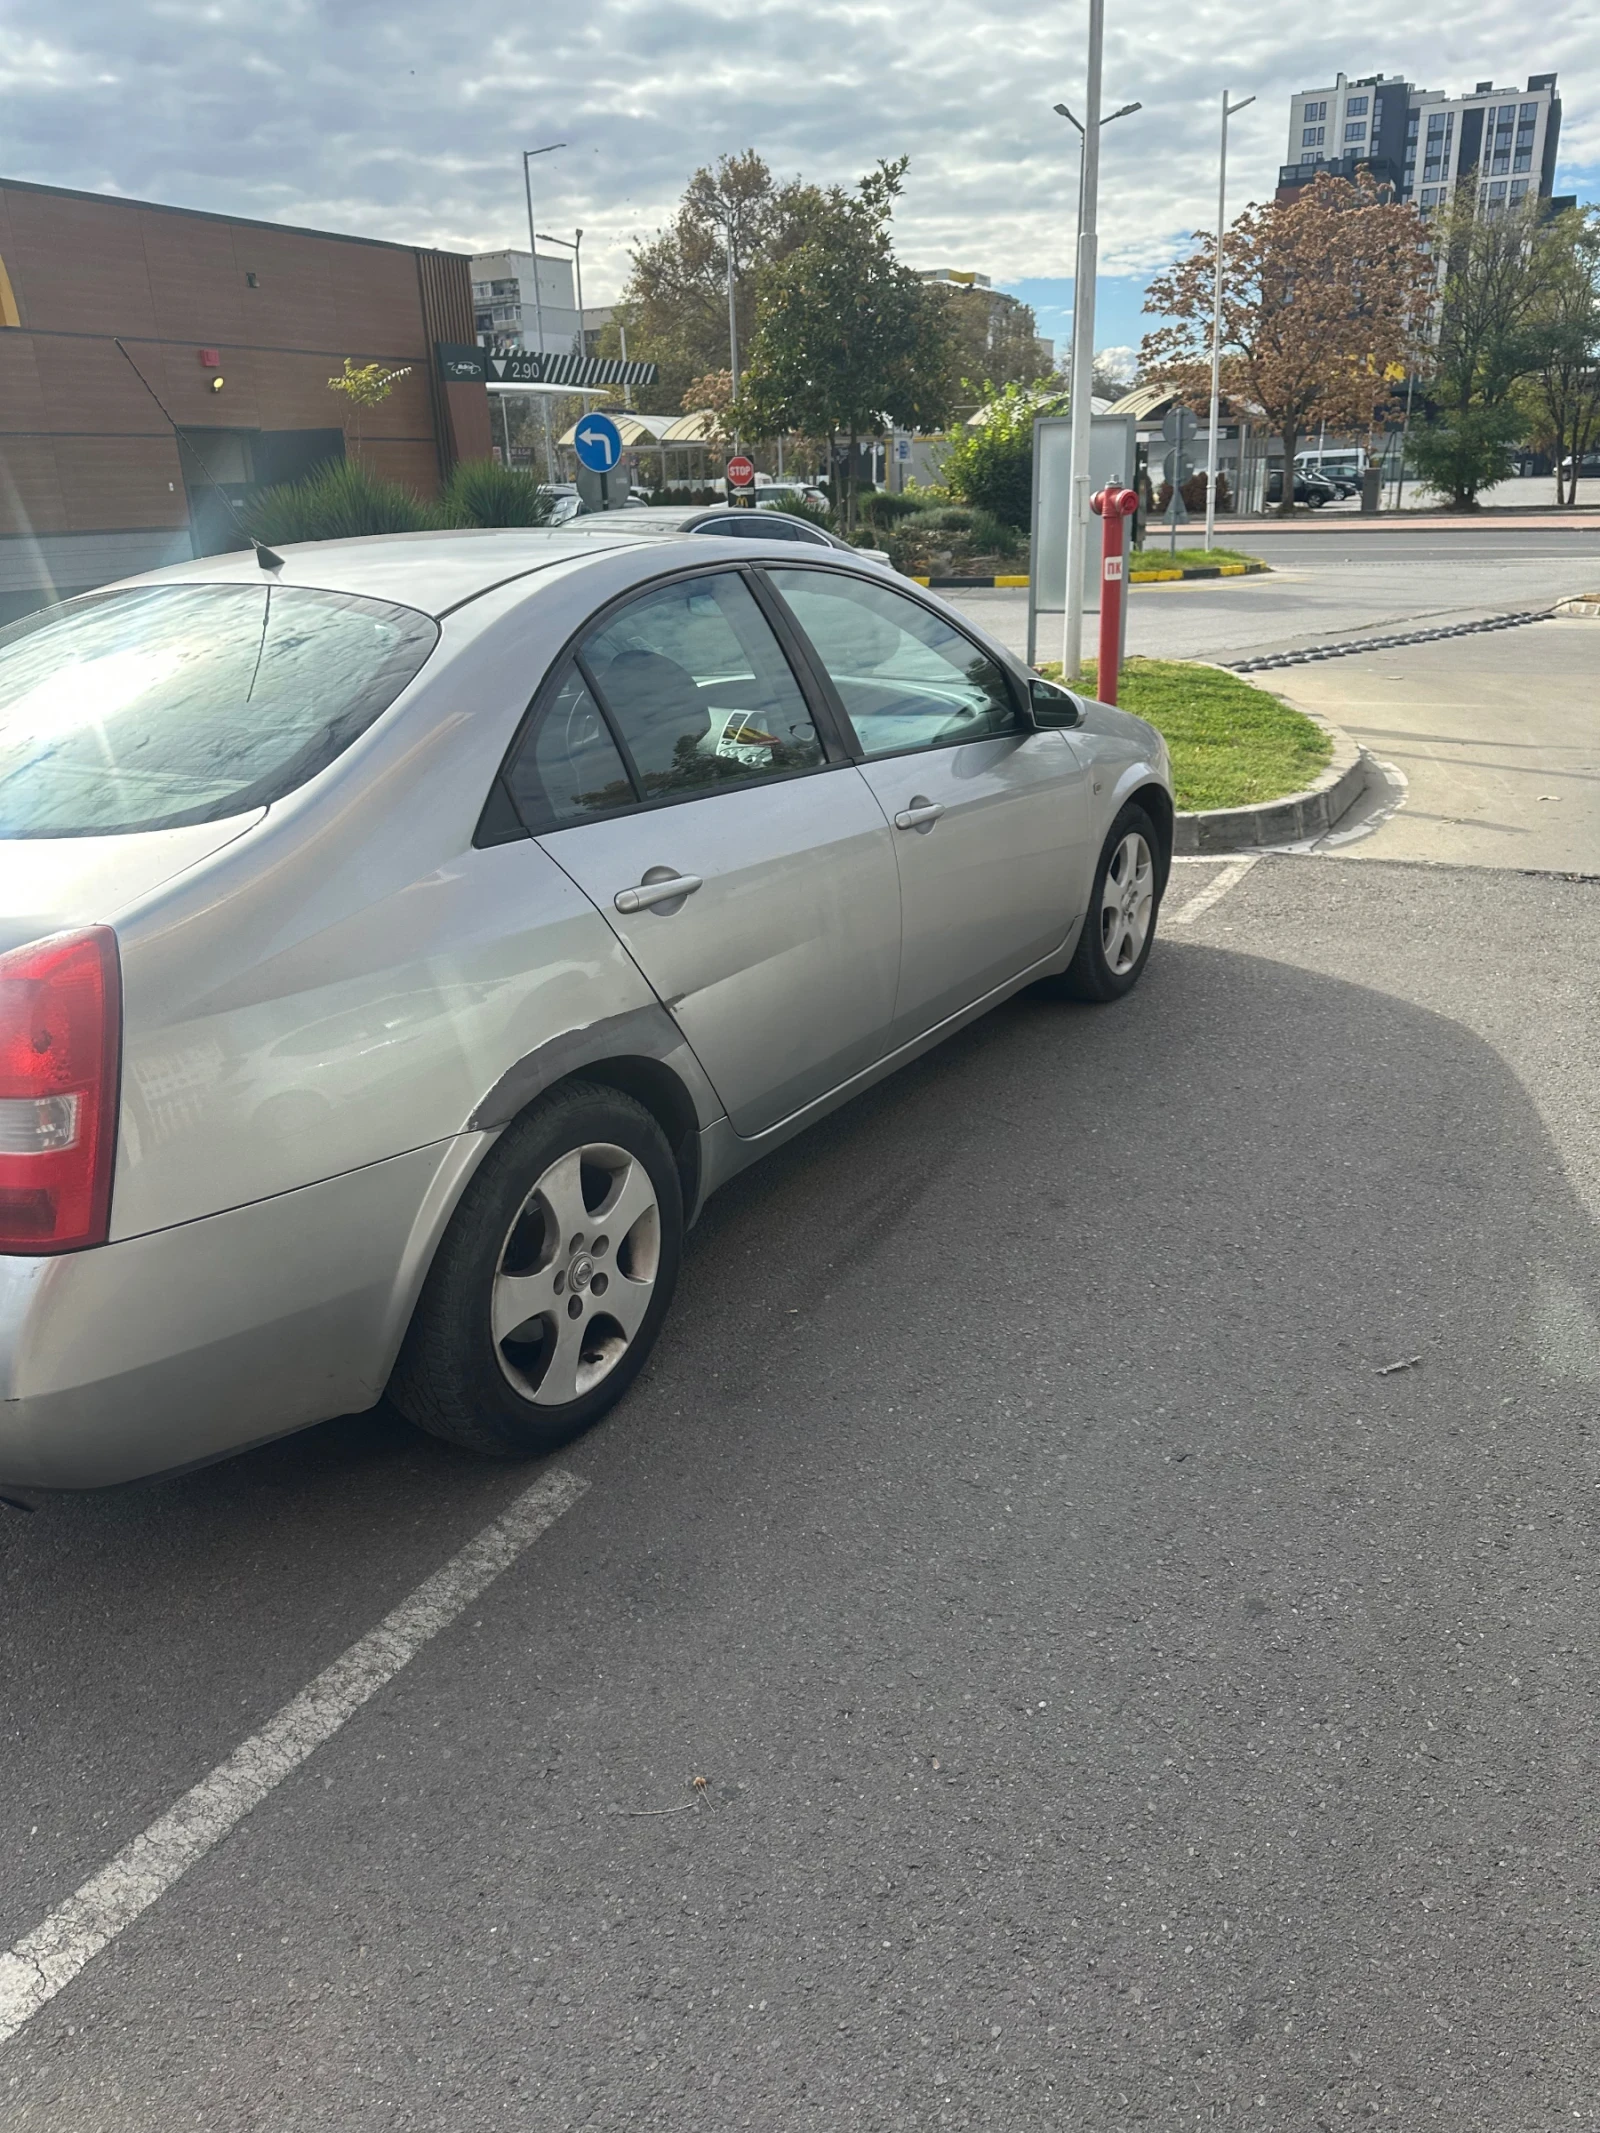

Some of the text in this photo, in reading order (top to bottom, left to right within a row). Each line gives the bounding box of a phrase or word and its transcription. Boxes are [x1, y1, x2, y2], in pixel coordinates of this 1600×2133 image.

[512, 362, 540, 379] 2.90
[729, 465, 751, 477] STOP
[1107, 562, 1122, 575] ПК
